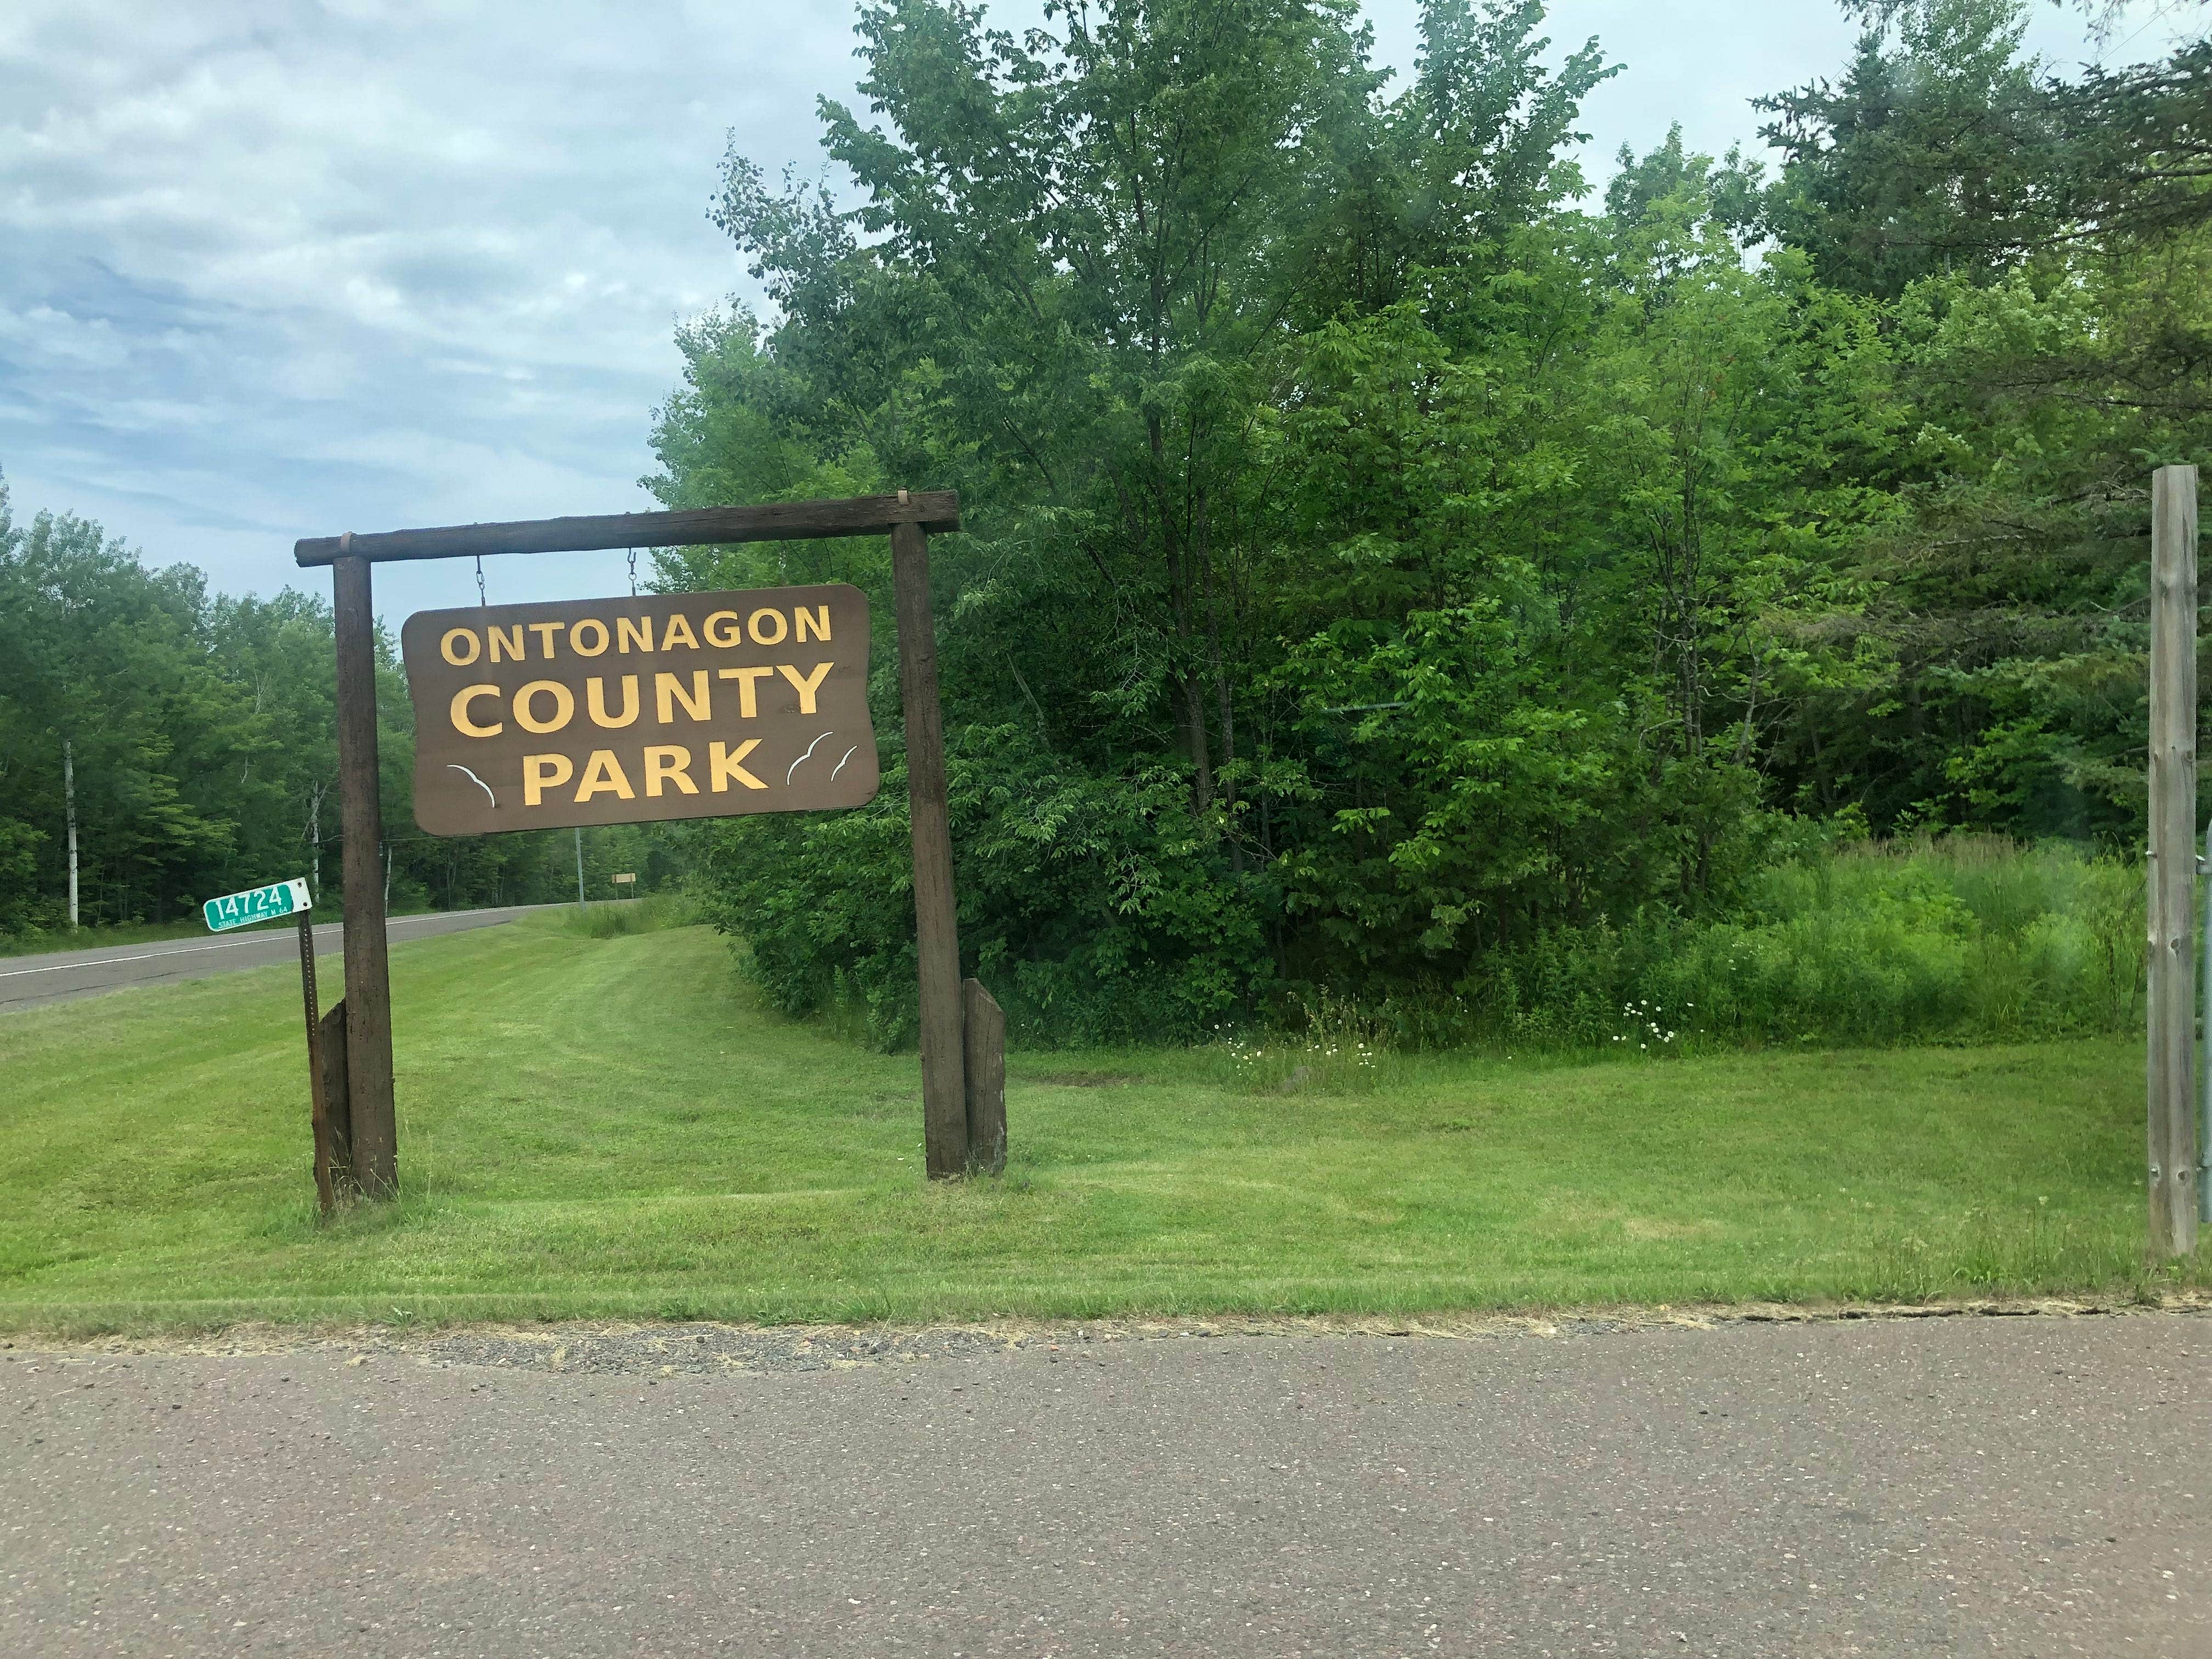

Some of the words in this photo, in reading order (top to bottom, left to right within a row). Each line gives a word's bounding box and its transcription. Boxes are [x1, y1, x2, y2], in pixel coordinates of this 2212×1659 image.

[440, 605, 832, 666] ONTONAGON
[450, 662, 834, 737] COUNTY
[523, 738, 769, 806] PARK
[215, 886, 281, 919] 14724
[218, 918, 237, 928] STATE
[240, 911, 268, 923] HIGHWAY
